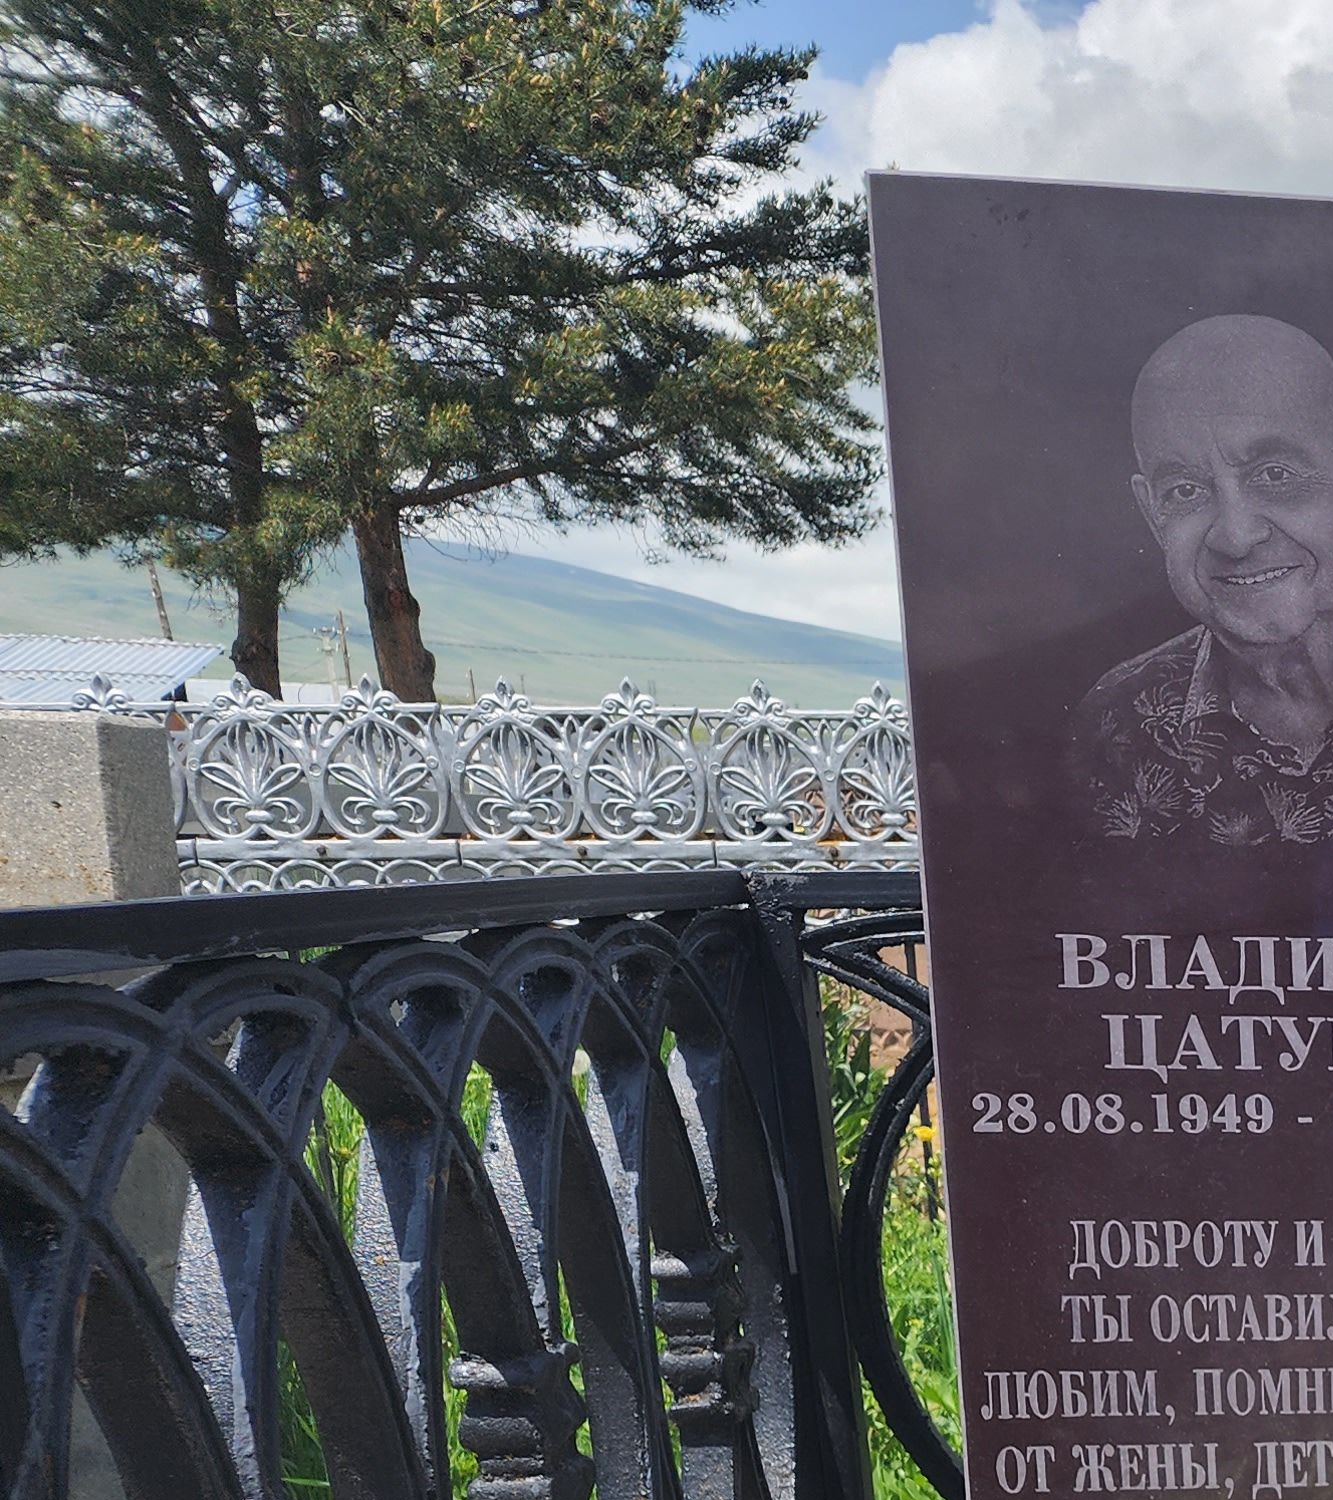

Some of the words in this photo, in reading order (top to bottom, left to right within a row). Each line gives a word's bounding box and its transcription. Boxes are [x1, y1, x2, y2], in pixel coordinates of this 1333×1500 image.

[971, 1092, 1274, 1135] 28.08.1949
[1069, 1219, 1280, 1281] ДОБРОТУ
[1293, 1219, 1327, 1267] И
[1060, 1294, 1134, 1343] ТЫ
[980, 1369, 1176, 1426] ЛЮБИМ,
[995, 1445, 1056, 1494] ОТ
[1071, 1442, 1235, 1500] ЖЕНЫ,
